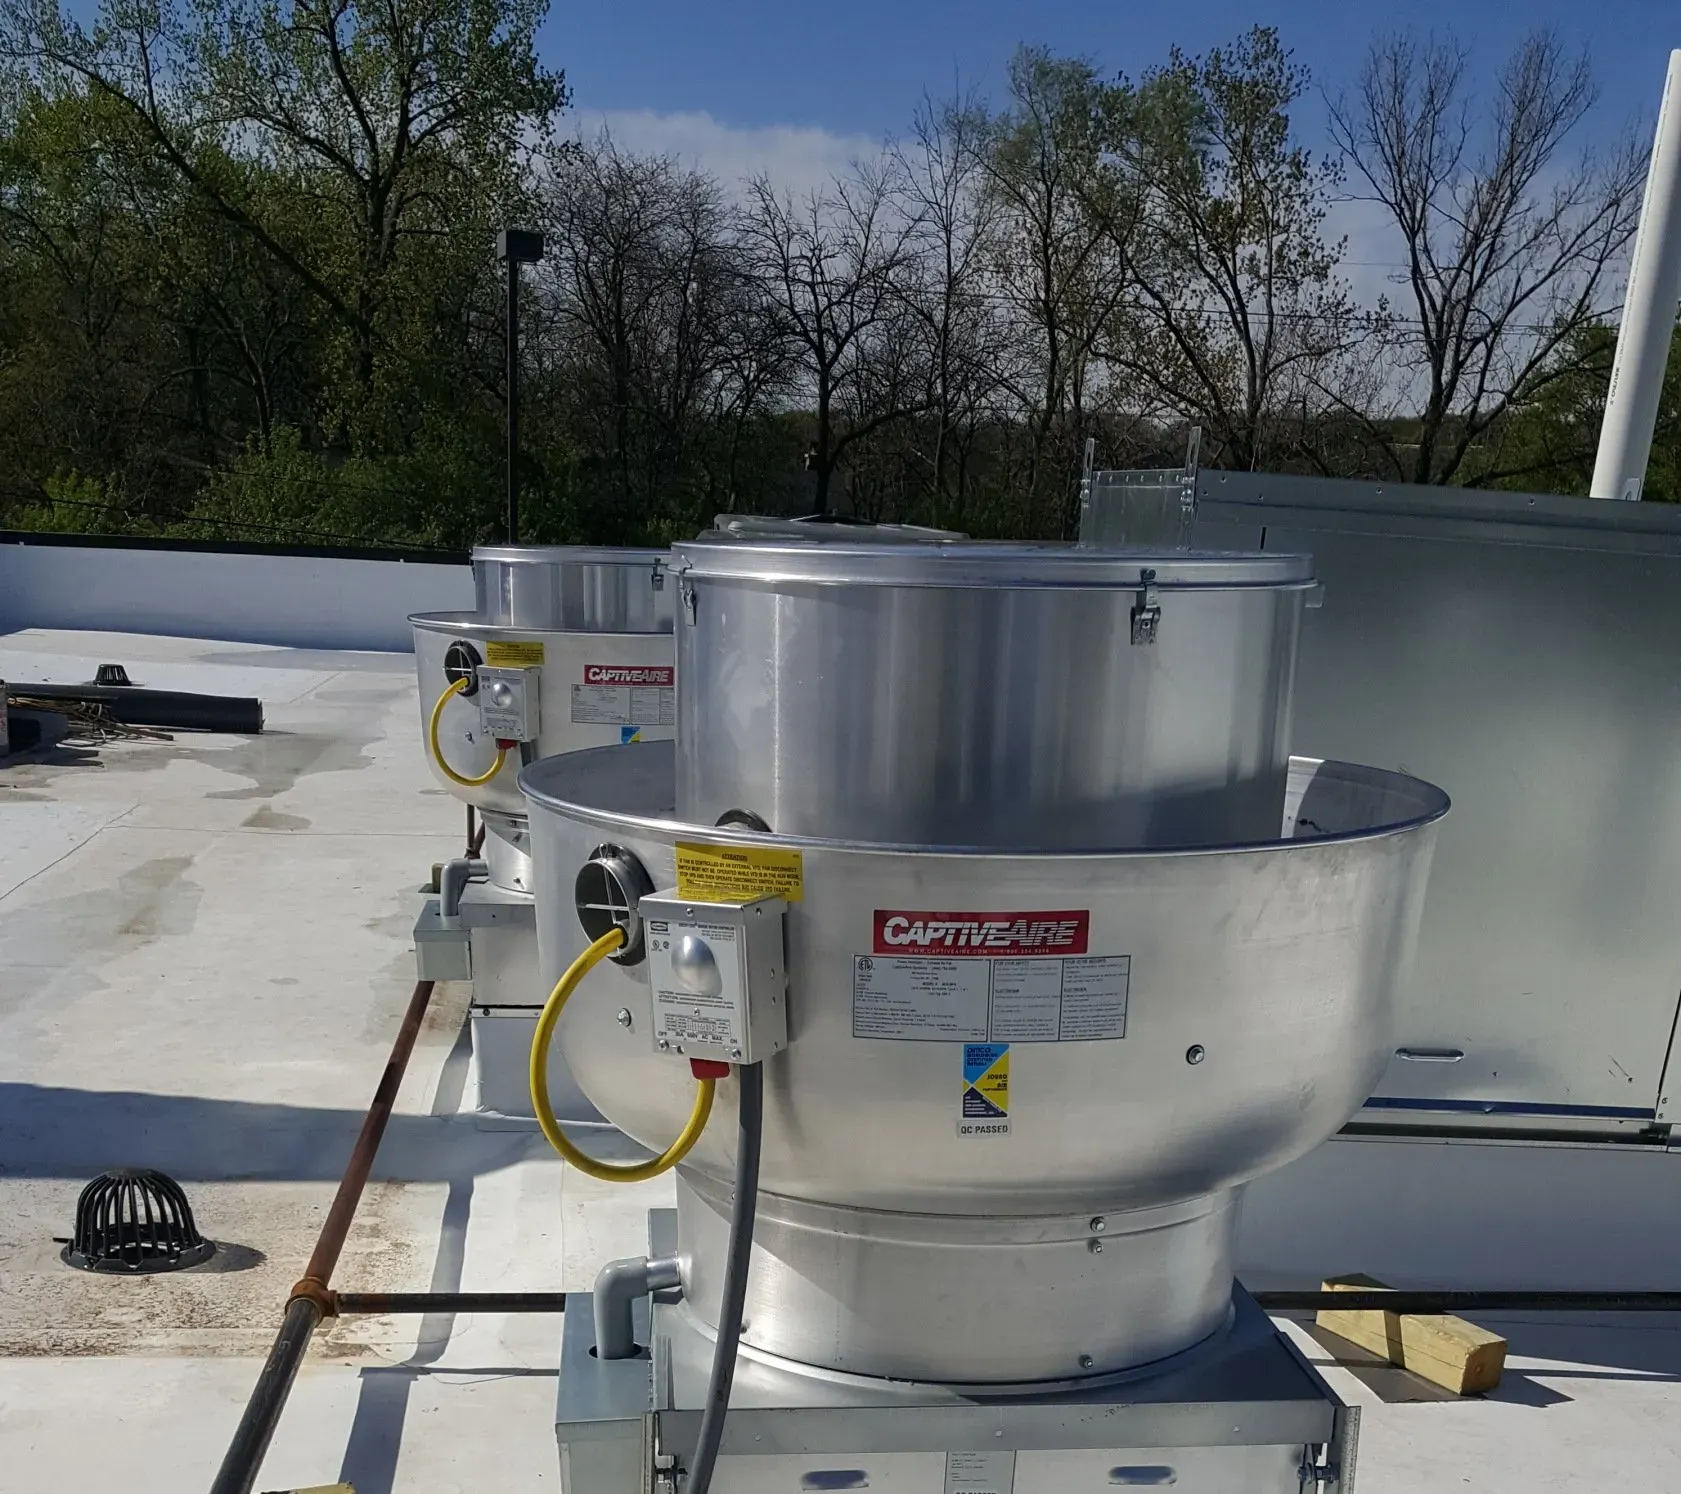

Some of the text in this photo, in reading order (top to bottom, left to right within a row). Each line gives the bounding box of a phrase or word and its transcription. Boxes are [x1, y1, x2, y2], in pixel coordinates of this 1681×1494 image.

[883, 916, 1080, 946] CAPTIVEAIRE
[960, 1125, 1008, 1134] QC PASSED
